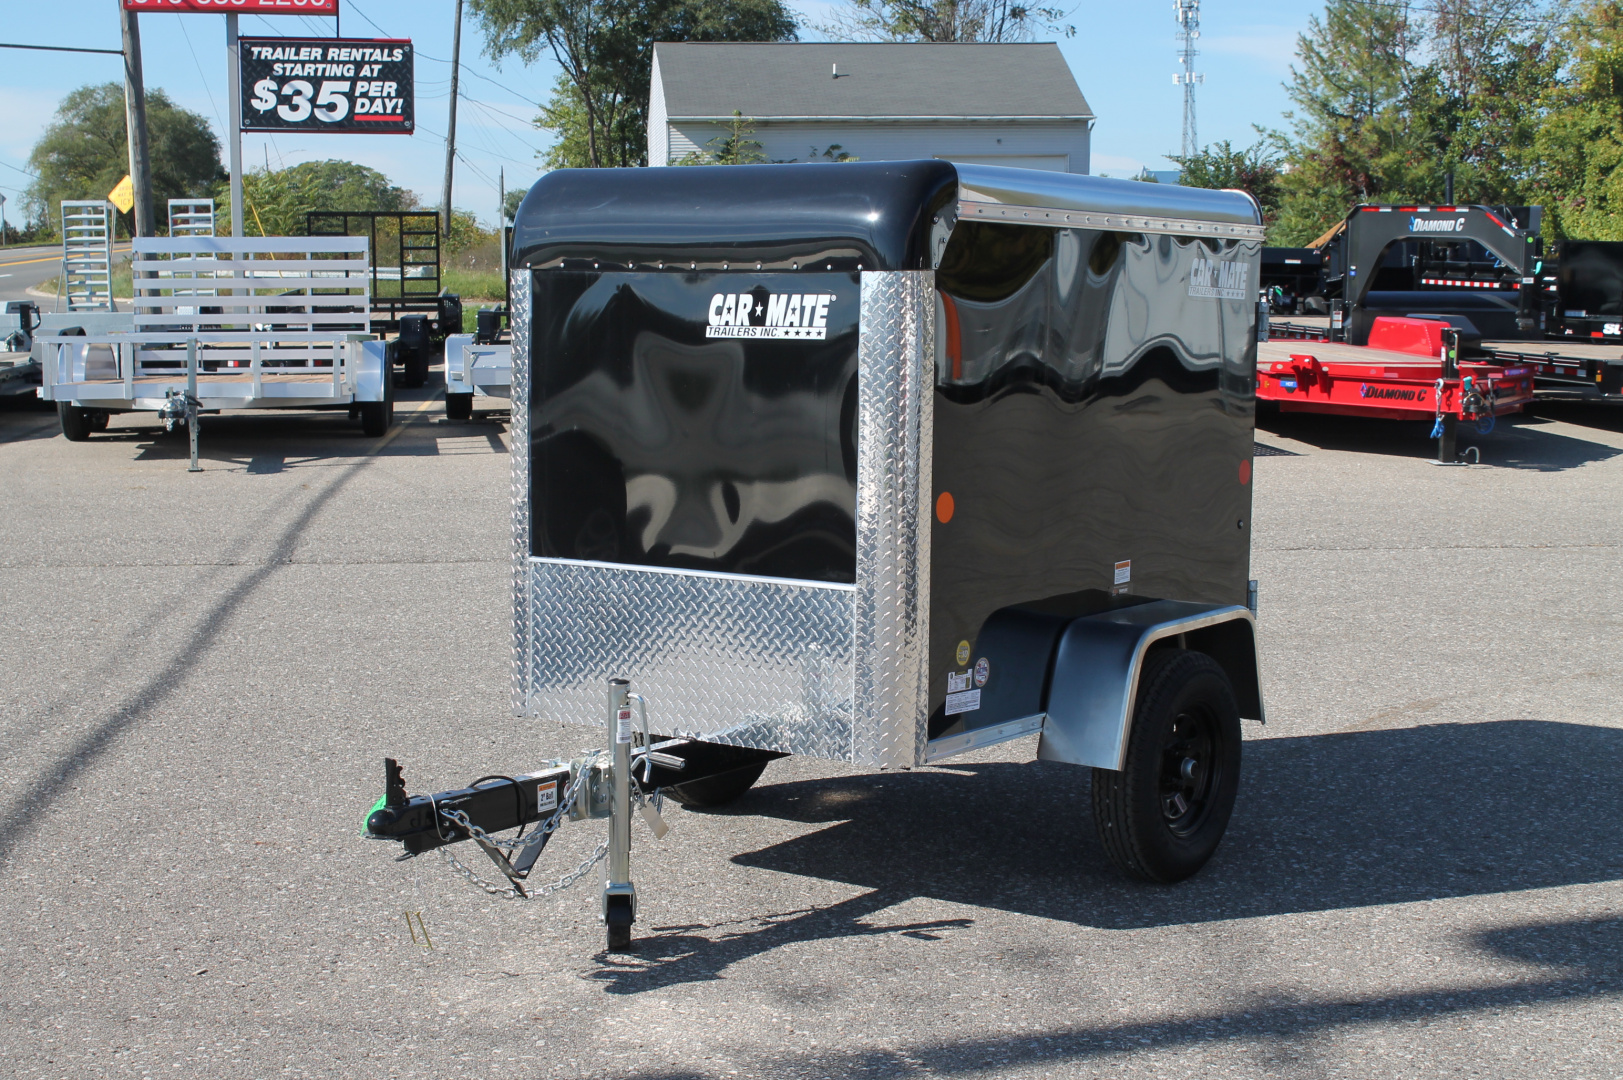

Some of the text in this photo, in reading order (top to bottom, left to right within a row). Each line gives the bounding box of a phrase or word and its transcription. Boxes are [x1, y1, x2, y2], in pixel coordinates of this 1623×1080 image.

[251, 47, 403, 62] TRAILER RENTALS
[273, 63, 382, 77] STARTING AT
[354, 81, 398, 97] PER
[250, 76, 351, 122] $35
[354, 98, 404, 114] DAY!
[120, 198, 131, 206] ICY
[1413, 217, 1465, 232] DIAMOND C
[1190, 258, 1248, 290] CAR MATE
[708, 293, 753, 326] CAR
[708, 327, 780, 337] TRAILERS INC.
[1366, 385, 1427, 401] DIAMOND C
